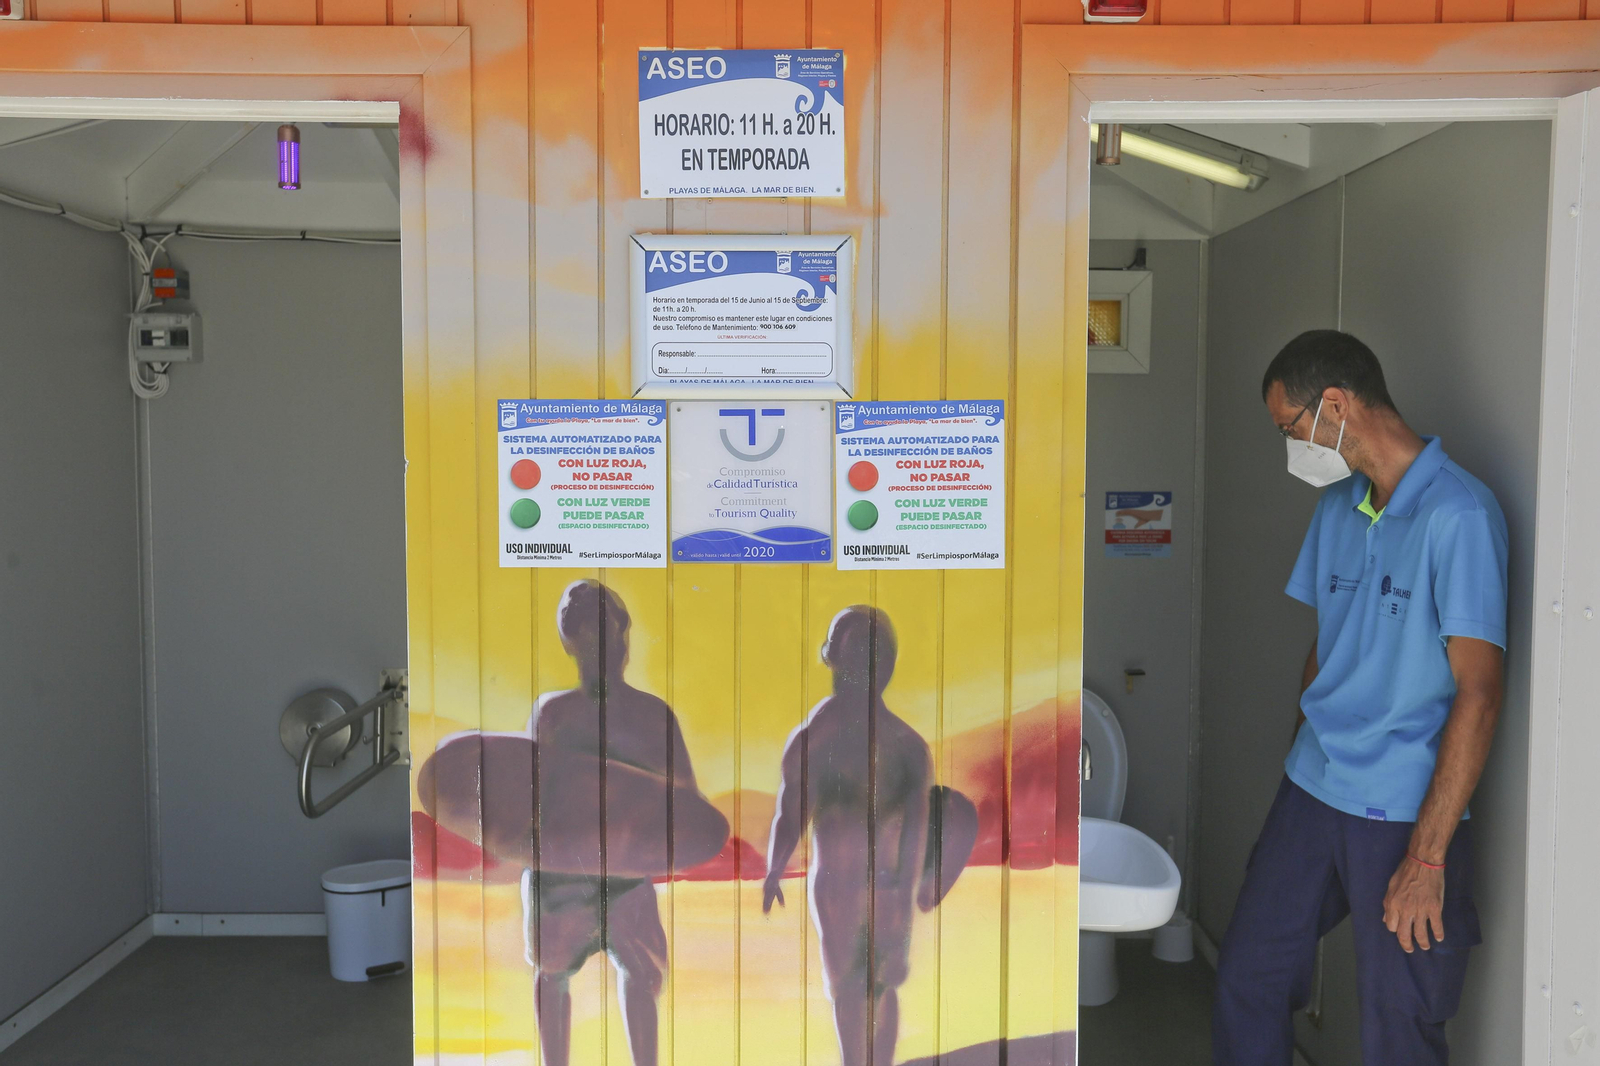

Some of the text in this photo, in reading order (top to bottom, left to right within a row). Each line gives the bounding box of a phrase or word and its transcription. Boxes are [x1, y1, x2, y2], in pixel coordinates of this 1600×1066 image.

[646, 56, 727, 79] ASEO
[654, 113, 835, 136] HORARIO: 11 H. a 20 H.
[682, 148, 810, 171] EN TEMPORADA
[713, 185, 748, 194] MÁLAGA.
[649, 251, 728, 273] ASEO
[770, 315, 786, 323] lugar
[658, 350, 696, 358] Responsable:
[520, 403, 662, 415] Ayuntamiento de Málaga
[858, 403, 1000, 416] Ayuntamiento de Málaga
[841, 437, 885, 445] SISTEMA
[888, 436, 969, 444] AUTOMATIZADO
[526, 445, 601, 454] DESINFECCIÓN
[619, 445, 655, 454] BAÑOS
[864, 446, 938, 456] DESINFECCIÓN
[957, 446, 992, 455] BAÑOS
[558, 459, 646, 469] CON LUZ ROJA,
[896, 459, 984, 469] CON LUZ ROJA,
[572, 472, 632, 481] NO PASAR
[719, 467, 785, 478] Compromiso
[910, 473, 970, 482] NO PASAR
[714, 479, 752, 488] Calidad
[753, 479, 798, 488] Turística
[557, 498, 650, 507] CON LUZ VERDE
[721, 496, 787, 506] Commitment
[895, 498, 988, 507] CON LUZ VERDE
[563, 511, 644, 520] PUEDE PASAR
[714, 508, 756, 518] Tourism
[760, 508, 797, 519] Quality
[901, 512, 982, 521] PUEDE PASAR
[506, 544, 573, 554] USO INDIVIDUAL
[744, 546, 775, 557] 2020
[844, 545, 910, 555] USO INDIVIDUAL
